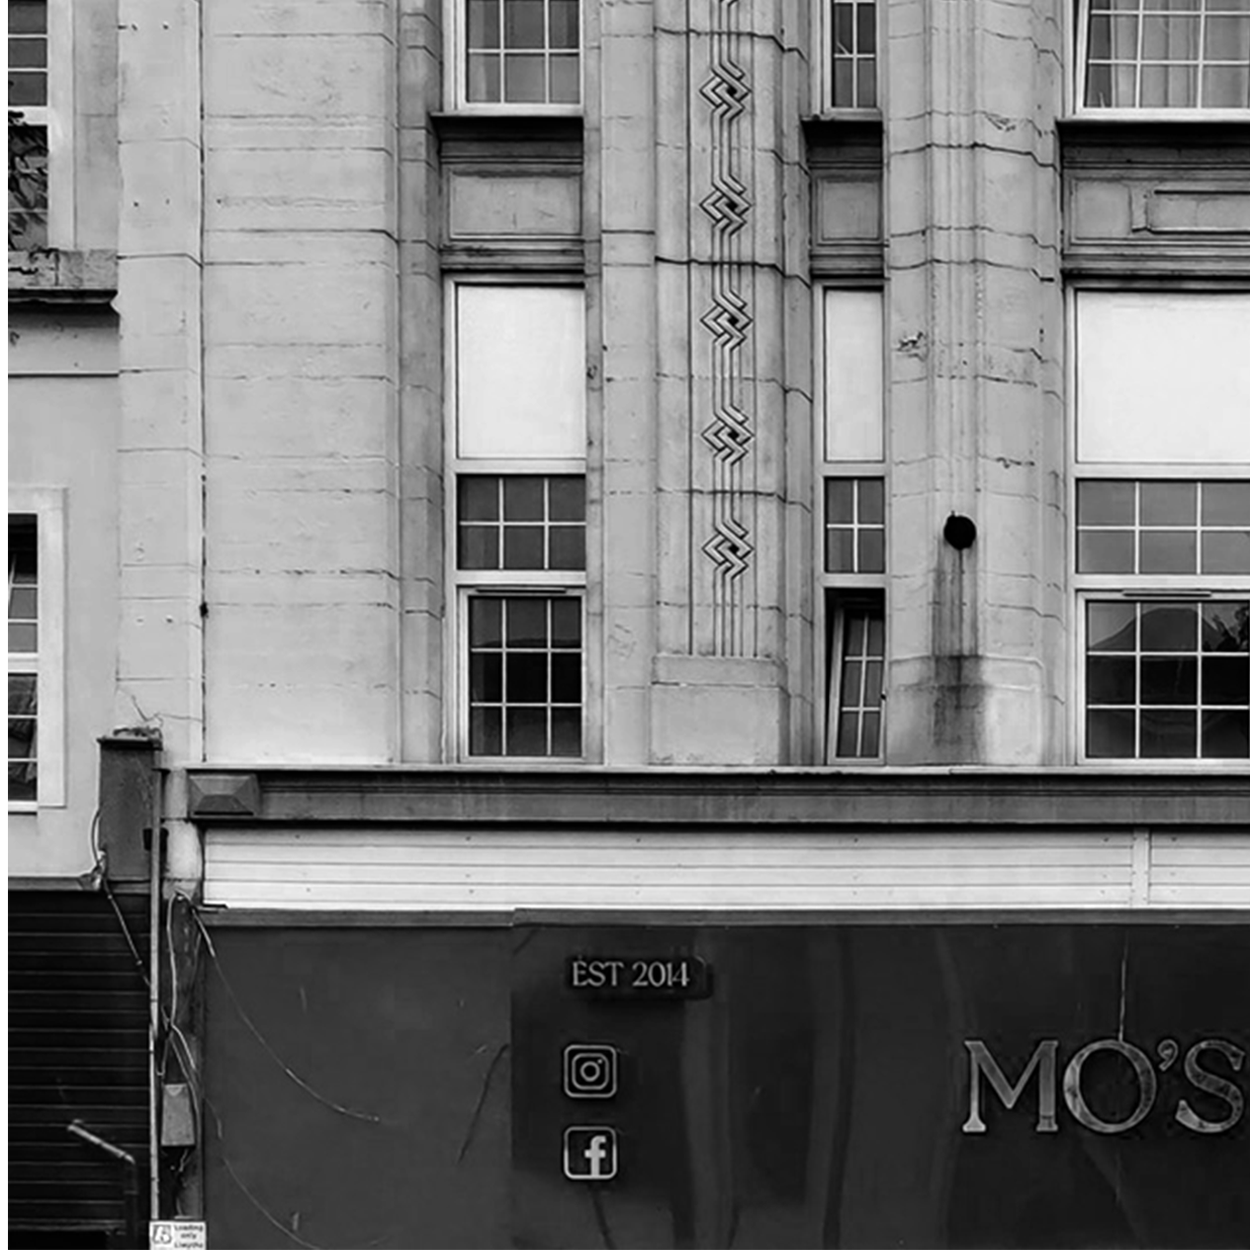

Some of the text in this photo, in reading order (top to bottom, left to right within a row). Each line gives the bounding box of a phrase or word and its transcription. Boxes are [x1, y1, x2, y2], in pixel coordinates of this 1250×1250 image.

[572, 960, 690, 987] EST 2014
[961, 1037, 1247, 1134] MO'S
